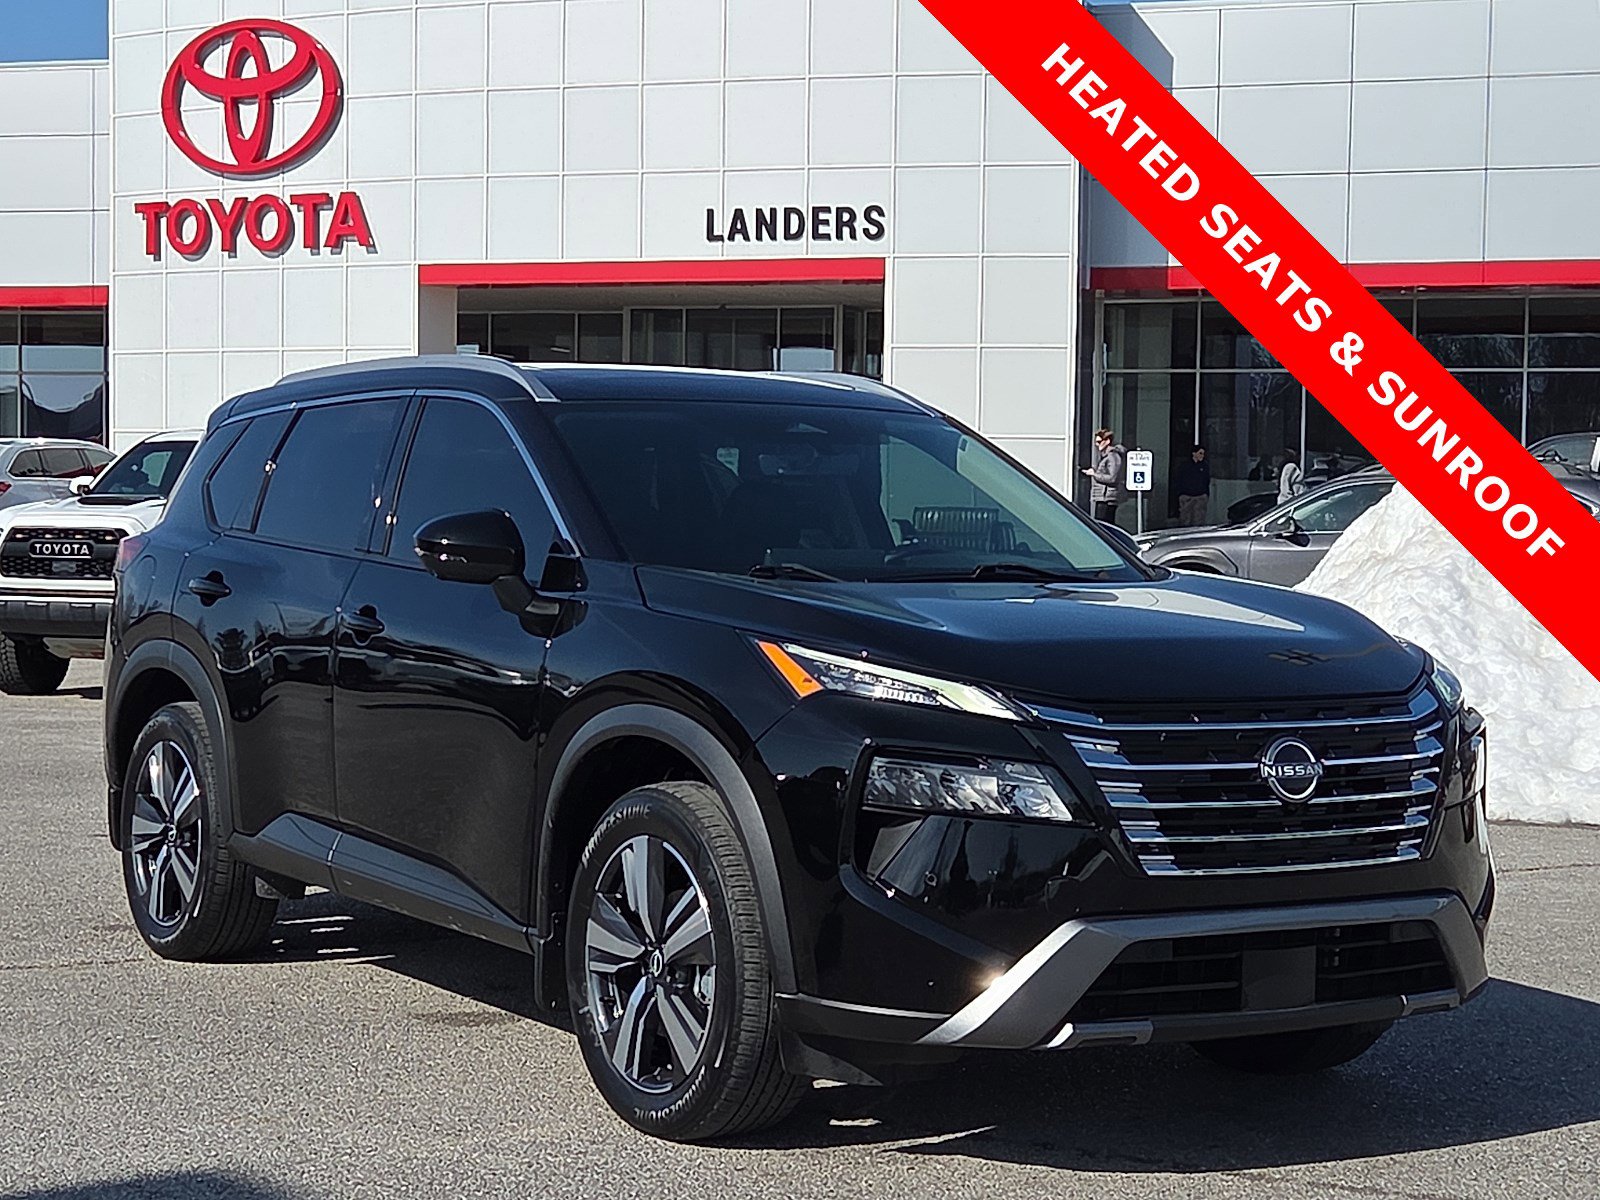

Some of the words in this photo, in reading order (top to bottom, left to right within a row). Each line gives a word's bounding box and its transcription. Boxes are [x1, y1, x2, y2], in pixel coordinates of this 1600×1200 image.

[135, 191, 374, 257] TOYOTA
[706, 205, 887, 243] LANDERS
[34, 543, 90, 555] TOYOTA
[1262, 764, 1323, 777] NISSAN
